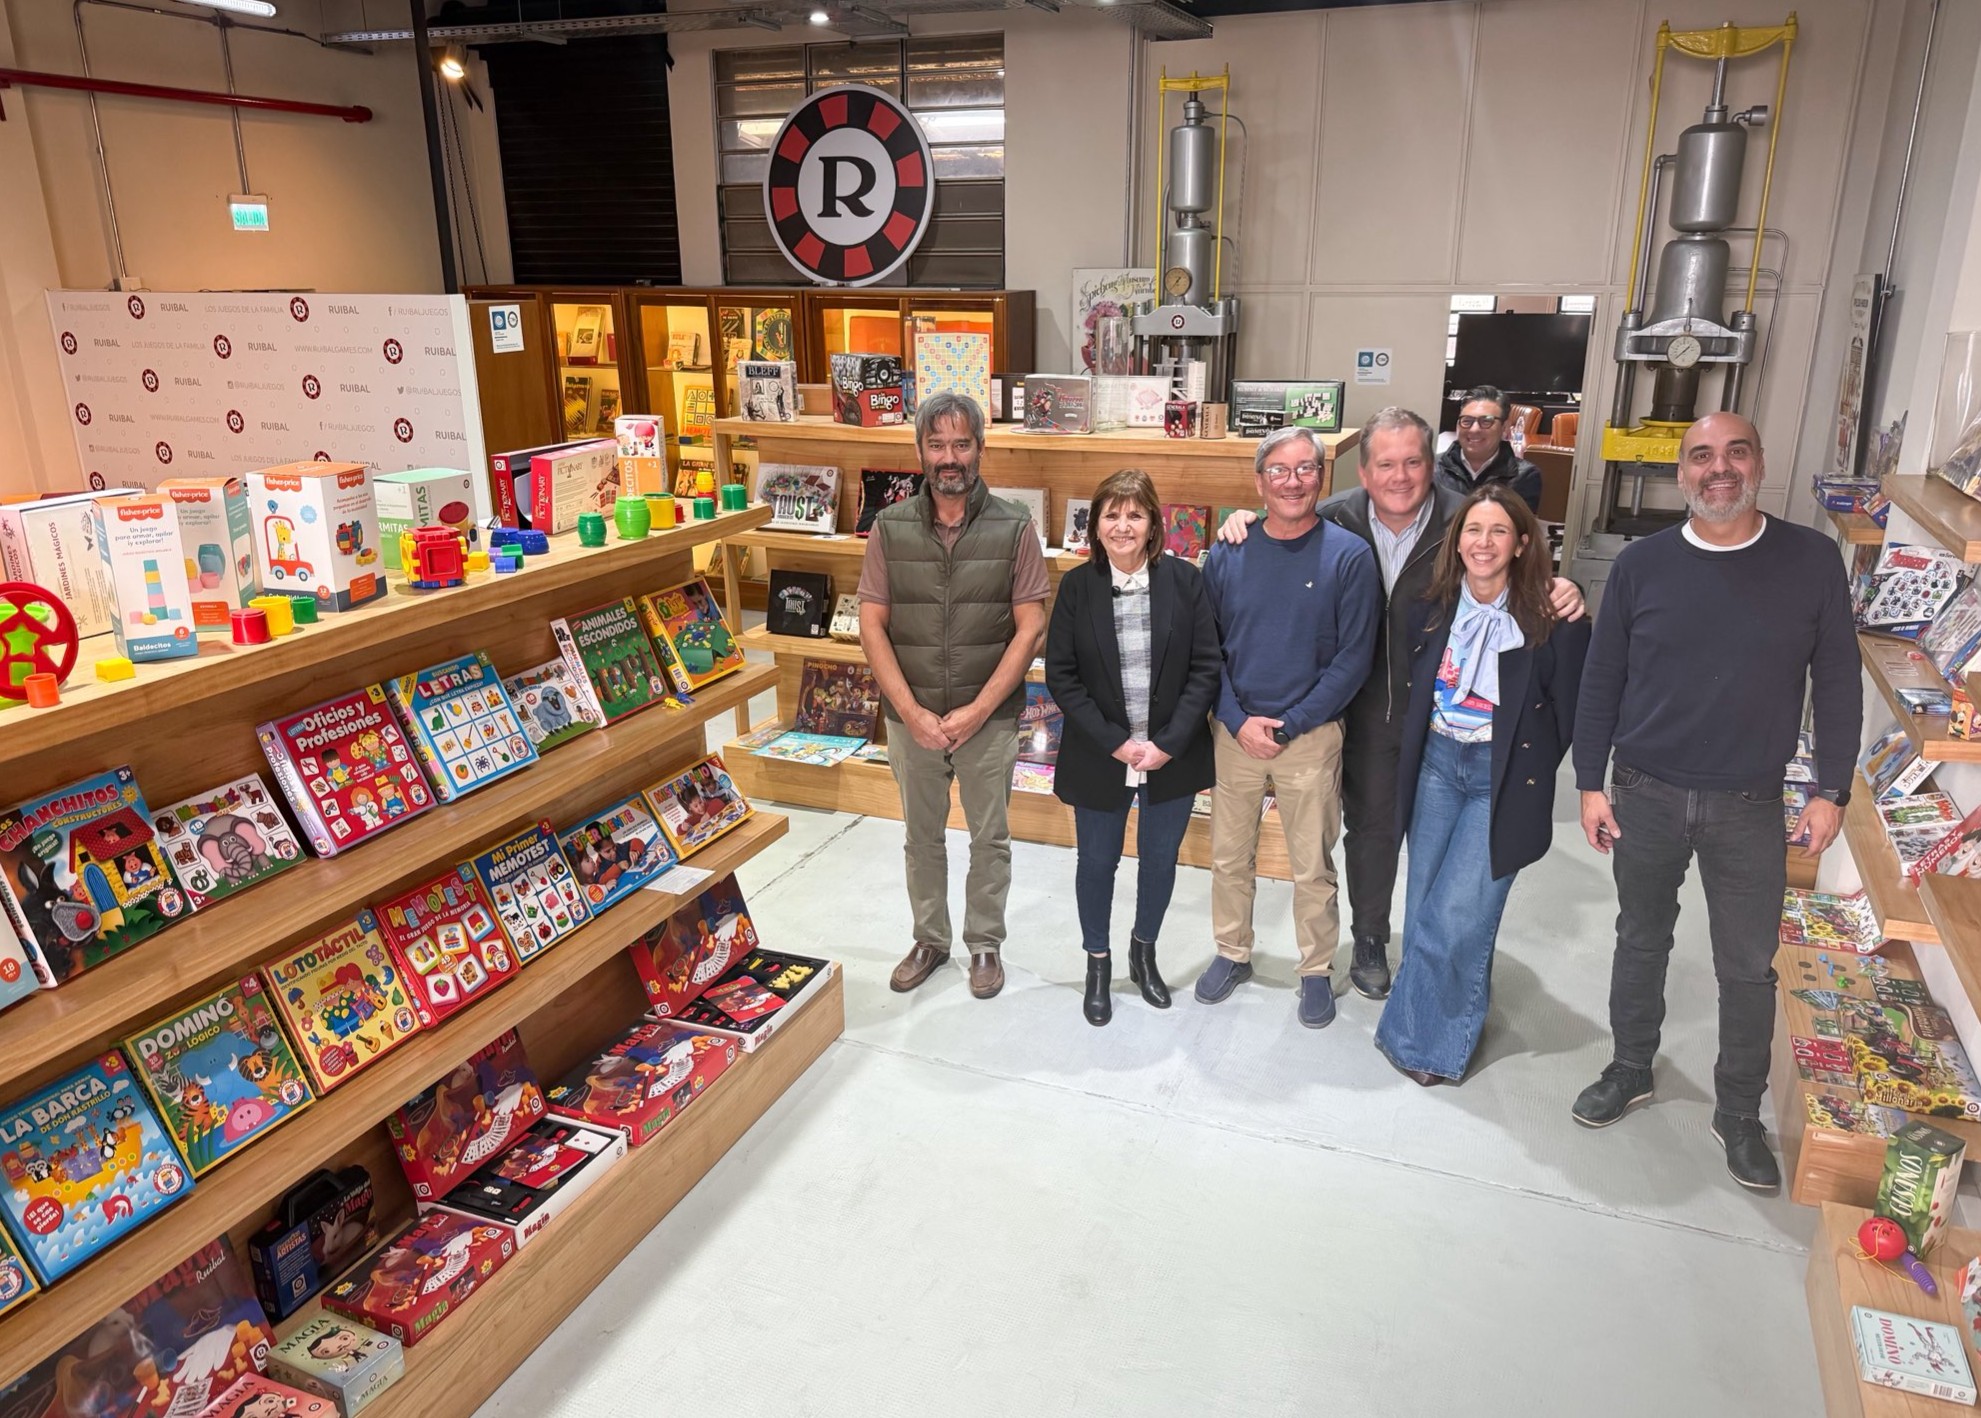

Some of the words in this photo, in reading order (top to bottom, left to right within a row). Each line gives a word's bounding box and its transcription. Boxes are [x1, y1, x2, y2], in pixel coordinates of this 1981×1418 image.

[817, 156, 876, 218] R
[160, 303, 189, 313] RUIBAL
[328, 305, 360, 315] RUIBAL
[93, 338, 120, 348] RUIBAL
[248, 342, 277, 352] RUIBAL
[424, 346, 457, 357] RUIBAL
[174, 377, 202, 387] RUIBAL
[748, 366, 780, 377] BLEFF
[340, 383, 371, 393] RUIBAL
[842, 376, 864, 397] Bingo
[870, 394, 899, 410] Bingo
[109, 413, 135, 423] RUIBAL
[261, 421, 290, 431] RUIBAL
[435, 430, 467, 441] RUIBAL
[187, 450, 215, 460] RUIBAL
[122, 480, 148, 490] RUIBAL
[266, 477, 300, 487] fisher-price
[171, 491, 209, 499] fisher-price
[499, 478, 512, 522] PICTIONARY
[538, 474, 549, 519] PICTIONARY
[120, 507, 161, 517] fisher-price
[48, 521, 63, 560] MAGICOS
[7, 545, 19, 582] ARDINES
[57, 562, 73, 600] JARDINES
[578, 617, 638, 647] ESCONDIDOS
[581, 607, 627, 633] ANIMALES
[133, 643, 172, 652] Baldecitos
[431, 664, 460, 678] BUSCANDO
[807, 662, 837, 671] PINOCHO
[416, 664, 484, 699] LETRAS
[303, 705, 355, 732] Oficios
[355, 701, 366, 717] y
[296, 711, 383, 753] Profesiones
[118, 769, 132, 781] 3+
[266, 746, 296, 804] Profesiones
[653, 778, 686, 805] MISTER
[683, 765, 710, 787] SABIO
[0, 783, 119, 852] CHANCHITOS
[52, 801, 123, 829] CONSTRUCTORES
[191, 821, 203, 831] 18
[488, 838, 552, 881] MEMOTEST
[491, 850, 504, 863] Mi
[505, 833, 539, 855] Primer
[1914, 839, 1951, 871] LETRAS
[194, 895, 206, 905] 3+
[387, 877, 477, 929] MEMOTEST
[399, 934, 406, 942] EL
[406, 929, 421, 940] GRAN
[421, 918, 436, 934] JUEGO
[436, 913, 443, 921] DE
[443, 910, 450, 918] LA
[450, 901, 471, 916] MEMORIA
[3, 962, 15, 975] 18
[243, 976, 258, 989] +4
[137, 992, 235, 1061] DOMINÓ
[609, 1023, 657, 1056] Magia
[105, 1056, 120, 1068] +3
[0, 1118, 33, 1144] LA
[31, 1077, 108, 1125] BARCA
[39, 1122, 52, 1134] DE
[52, 1113, 71, 1128] DON
[70, 1090, 111, 1119] RASTRILLO
[1874, 1092, 1924, 1108] Millonaria
[1889, 1150, 1923, 1217] GUSANOS
[27, 1209, 37, 1220] ¡El
[37, 1201, 50, 1214] que
[345, 1188, 372, 1213] Mago
[32, 1215, 42, 1226] se
[42, 1207, 54, 1219] cae
[36, 1211, 60, 1233] pierde!
[523, 1212, 551, 1240] Magia
[276, 1232, 307, 1261] ARTISTAS
[195, 1250, 226, 1284] Ruibal
[279, 1318, 330, 1354] MAGIA
[201, 1380, 255, 1418] MAGIA
[361, 1375, 389, 1403] MAGIA
